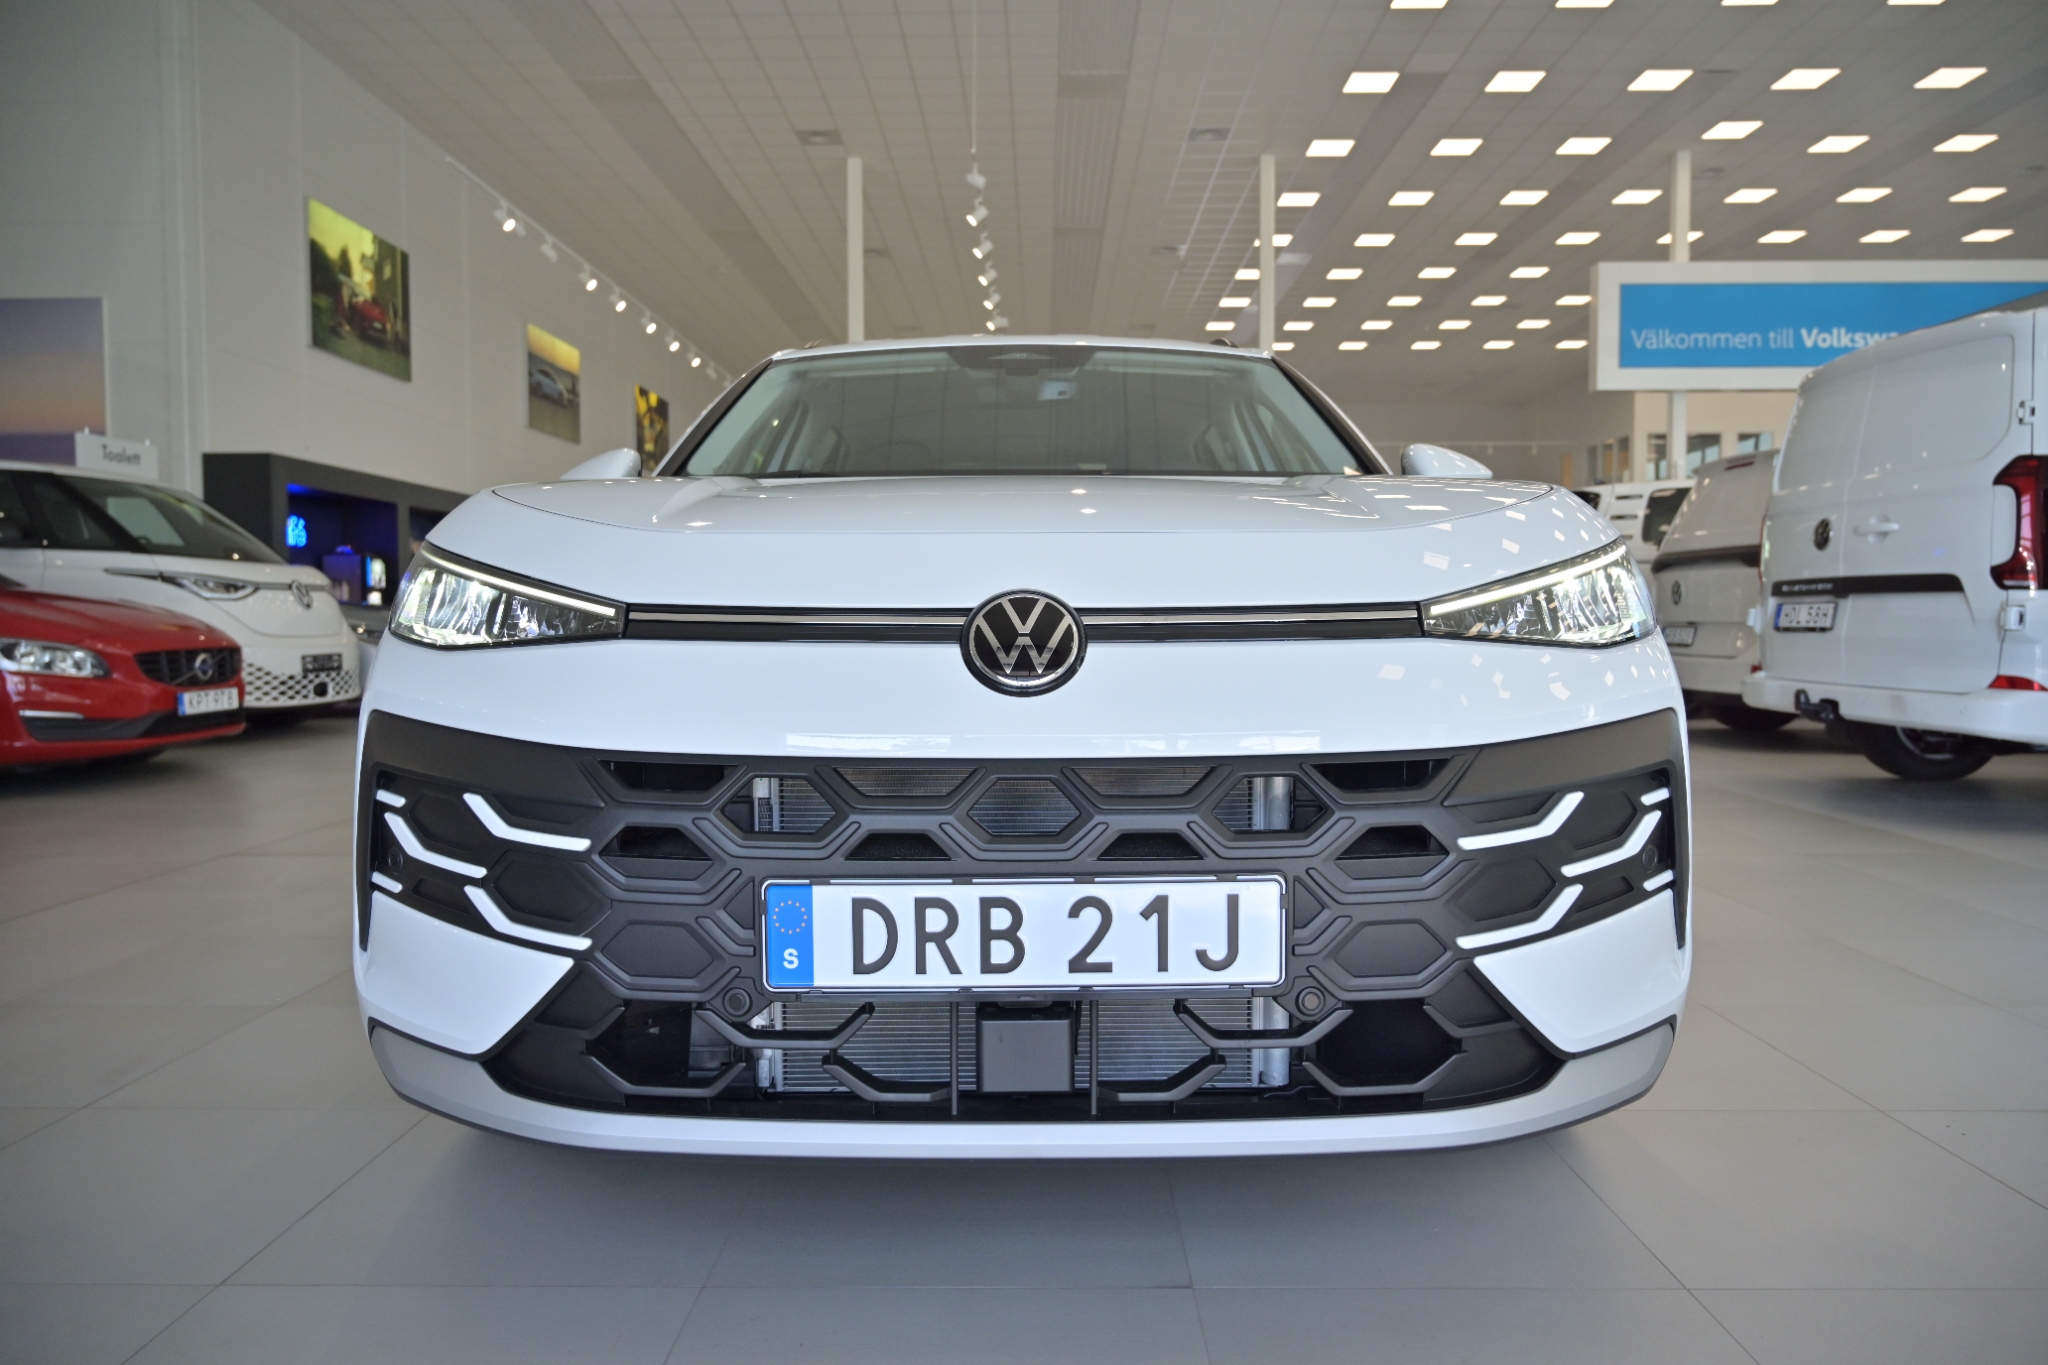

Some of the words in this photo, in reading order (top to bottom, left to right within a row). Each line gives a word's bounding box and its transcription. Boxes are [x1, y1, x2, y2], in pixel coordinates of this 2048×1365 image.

[1631, 328, 1762, 349] Välkommen
[1768, 327, 1795, 349] till
[101, 443, 142, 466] Toalett
[189, 691, 210, 710] KPT
[851, 896, 1027, 975] DRB
[1067, 894, 1240, 974] 21J
[783, 948, 800, 969] S
